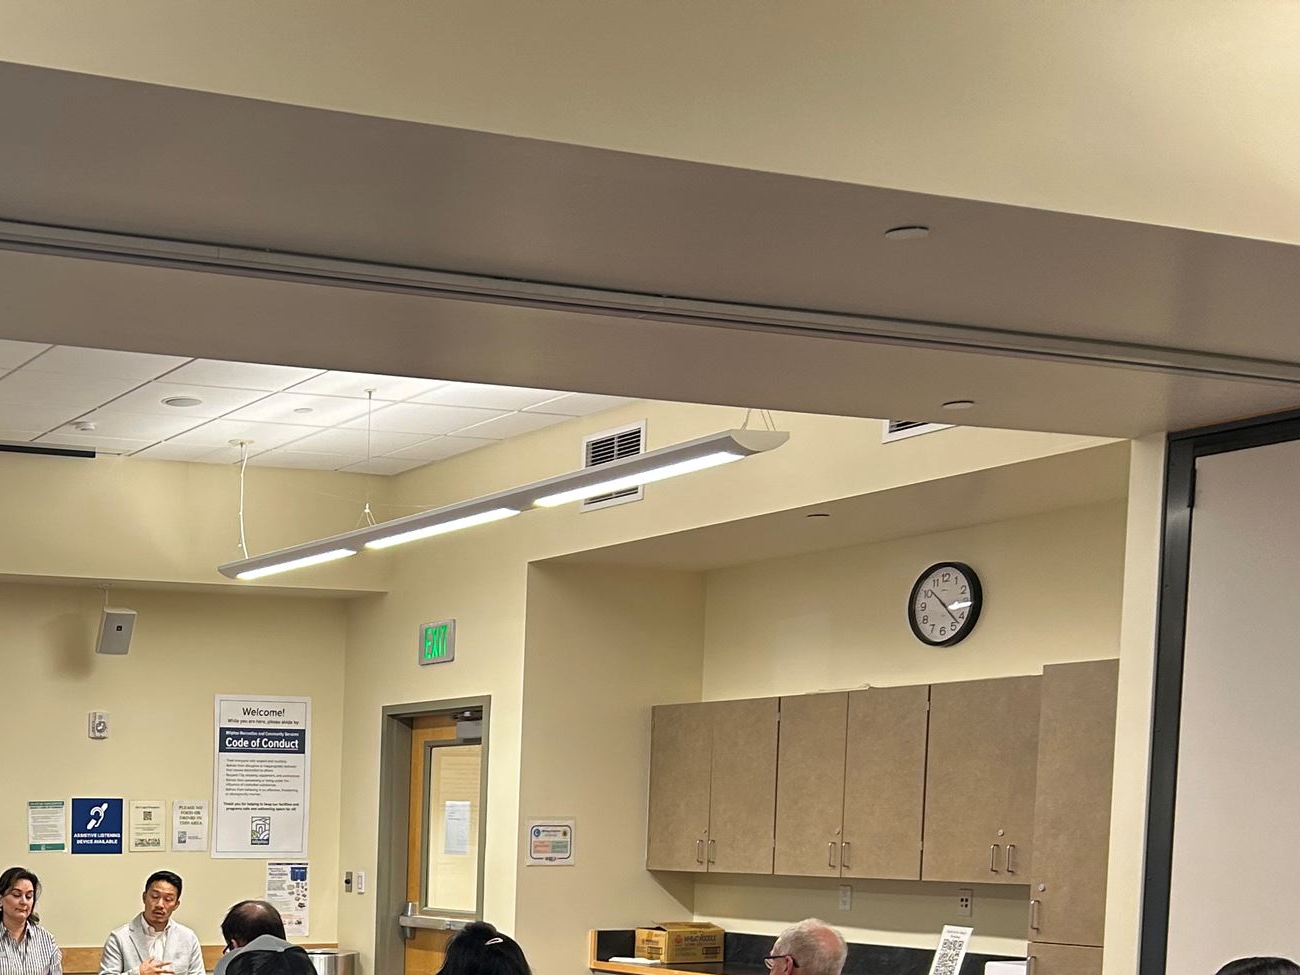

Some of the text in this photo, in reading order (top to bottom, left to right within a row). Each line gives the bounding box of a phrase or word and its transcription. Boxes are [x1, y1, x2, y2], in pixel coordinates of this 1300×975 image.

[424, 625, 448, 659] EXIT
[242, 707, 285, 717] Welcome!
[226, 738, 298, 748] Code of Conduct
